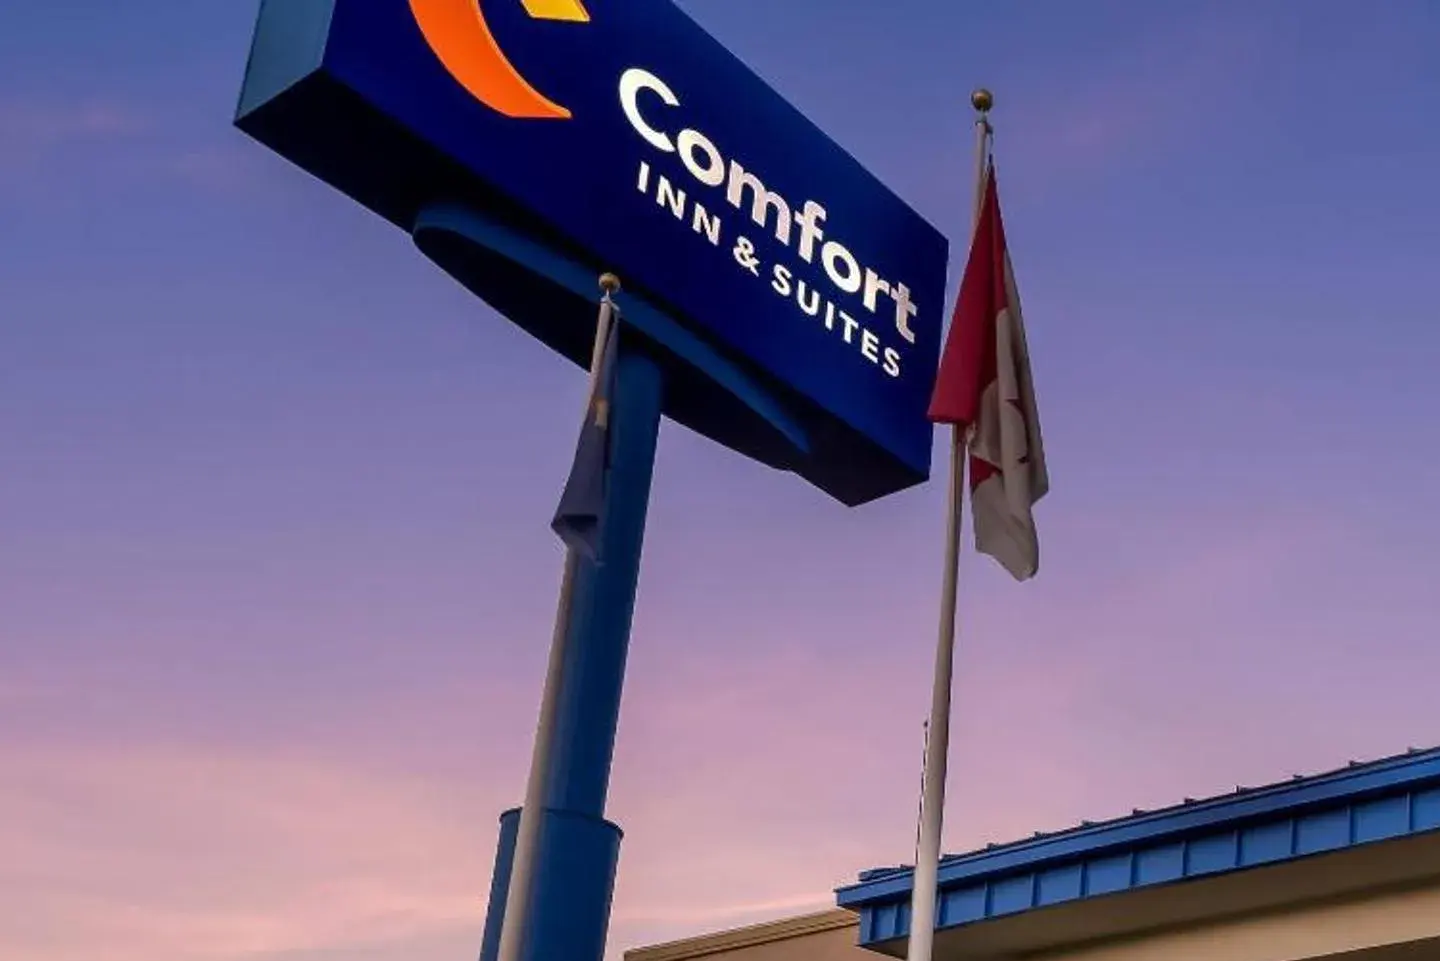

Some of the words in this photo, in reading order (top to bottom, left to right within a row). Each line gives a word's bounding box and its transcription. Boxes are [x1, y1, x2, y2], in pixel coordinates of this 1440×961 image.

[619, 68, 917, 344] Comfort
[637, 160, 721, 246] INN
[732, 235, 760, 277] &
[771, 263, 901, 377] SUITES
